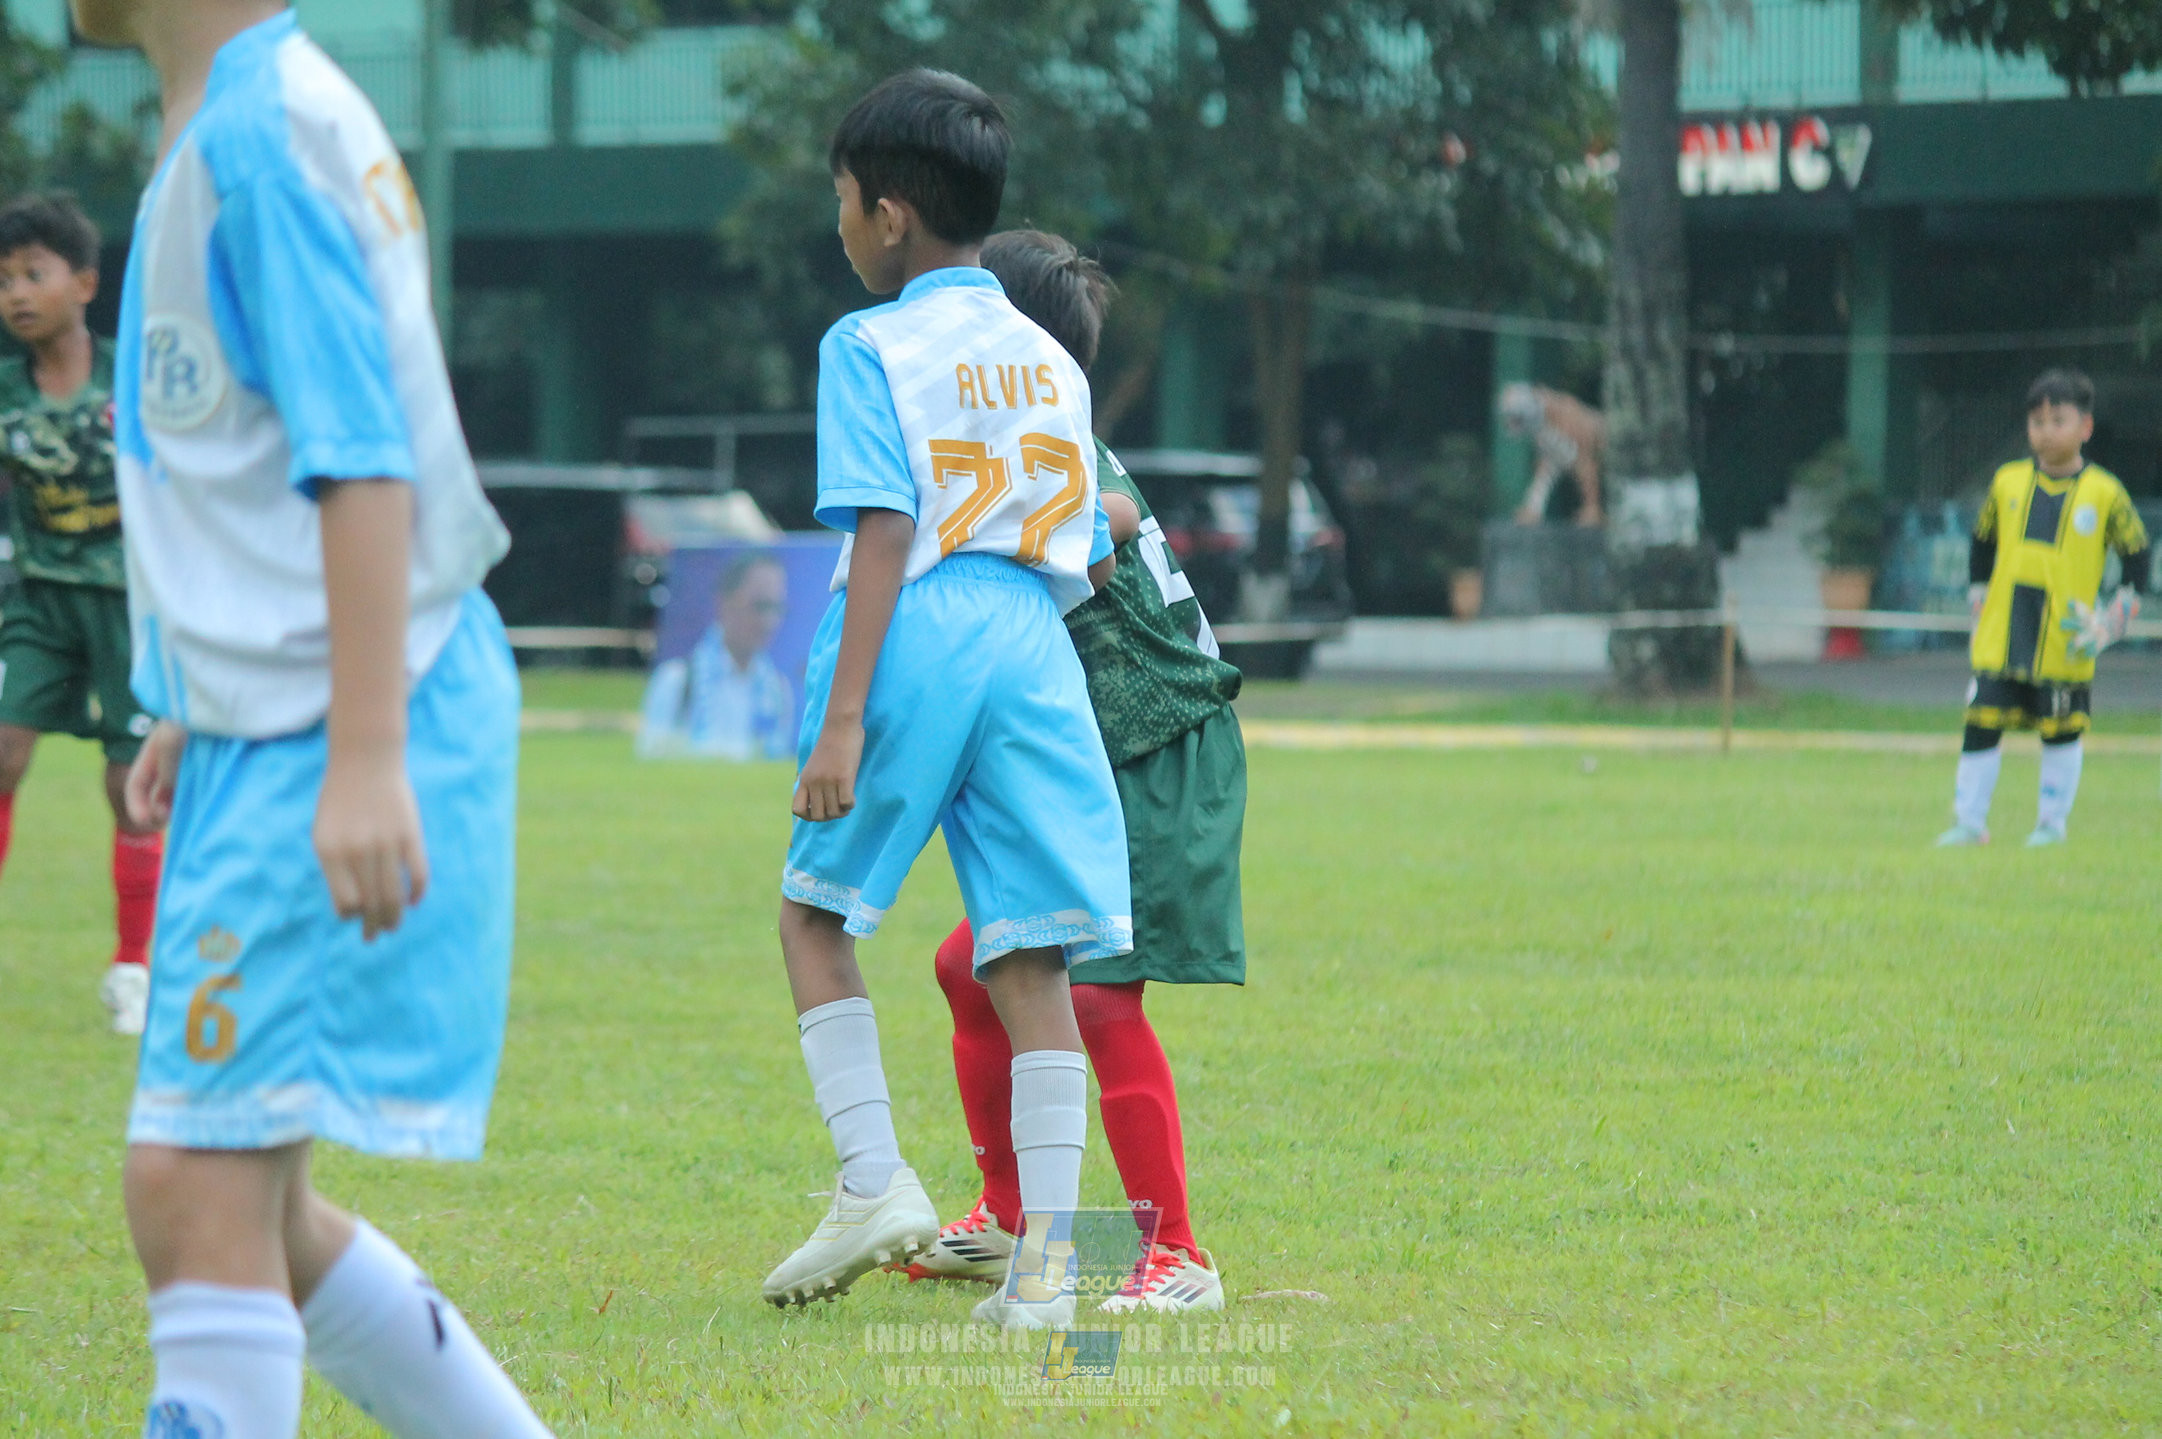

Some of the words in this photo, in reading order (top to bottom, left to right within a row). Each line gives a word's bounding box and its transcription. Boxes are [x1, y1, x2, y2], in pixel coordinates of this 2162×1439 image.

[955, 363, 1059, 409] ALVIS
[928, 432, 1088, 567] 77
[186, 974, 242, 1065] 6
